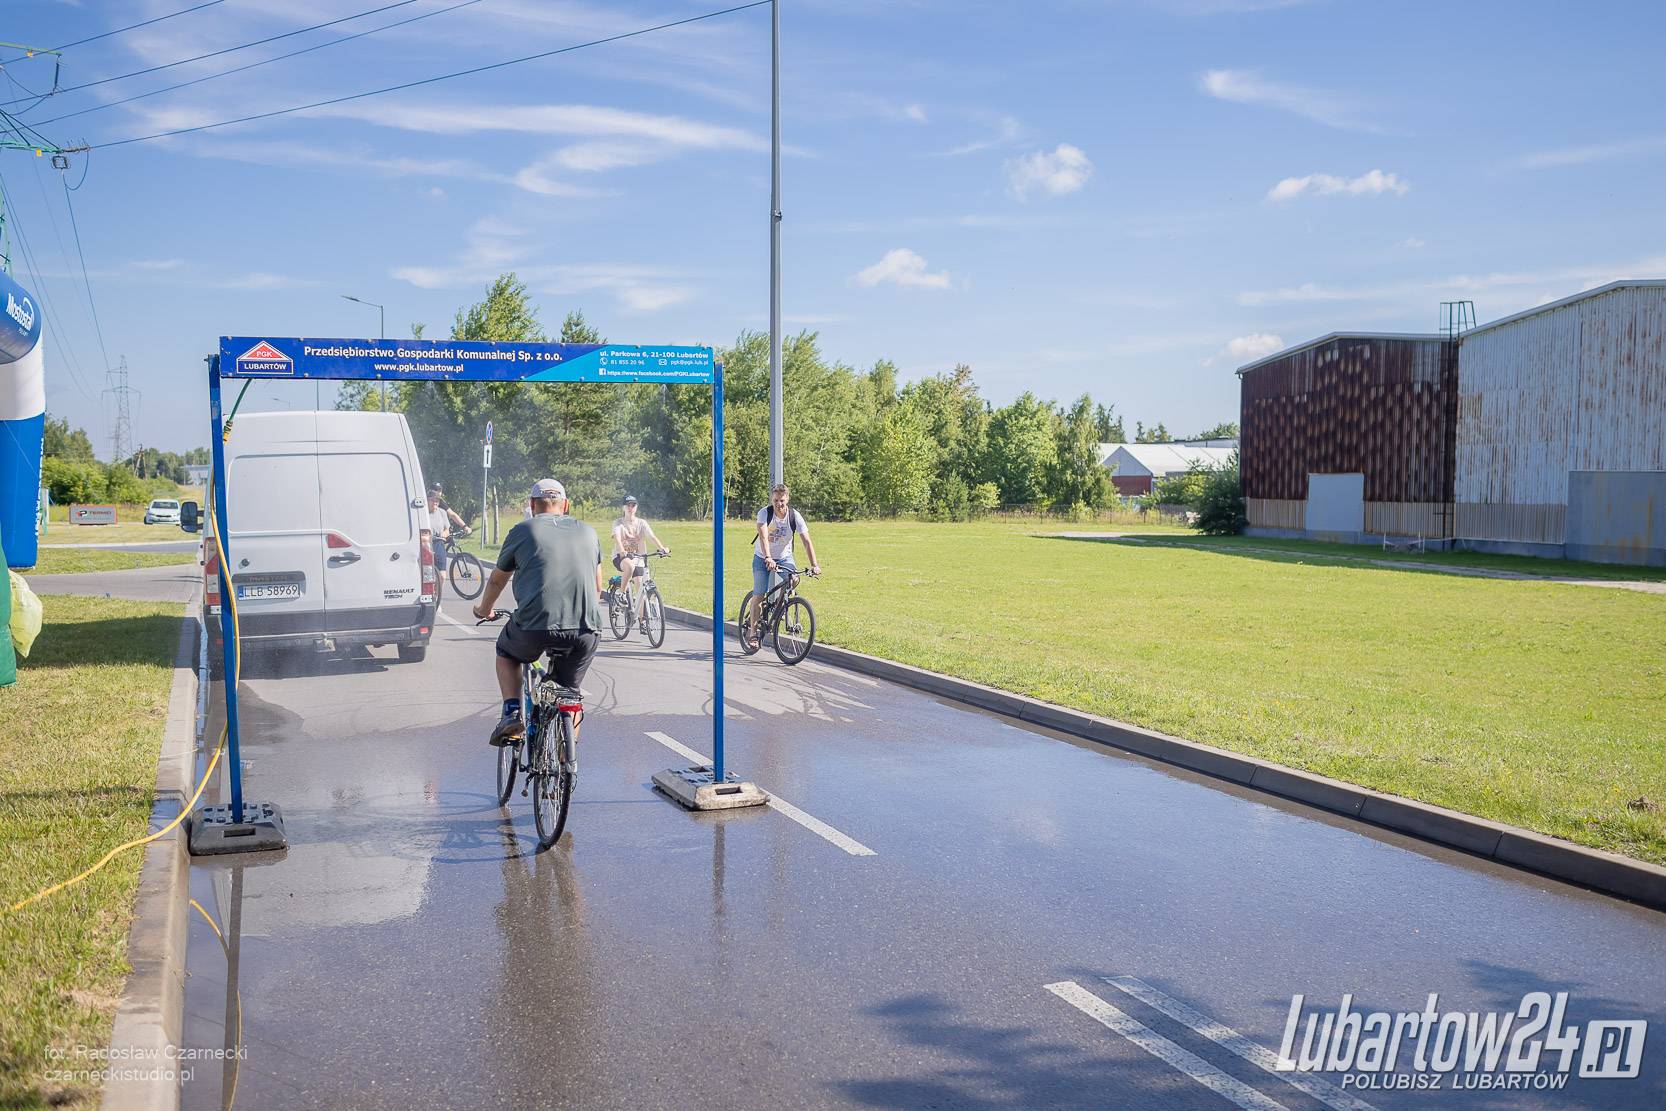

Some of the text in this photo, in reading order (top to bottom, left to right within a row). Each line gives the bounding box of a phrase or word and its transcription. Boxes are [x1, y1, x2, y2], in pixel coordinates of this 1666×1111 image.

[304, 346, 394, 359] Przedsiębiorstwo
[397, 348, 454, 359] Gospodarki
[456, 350, 516, 361] Komunalnej
[518, 351, 534, 361] Sp.
[544, 353, 563, 361] o.o.
[374, 363, 464, 372] www.pgk.lubartow.pl
[244, 585, 298, 597] LLB 58969
